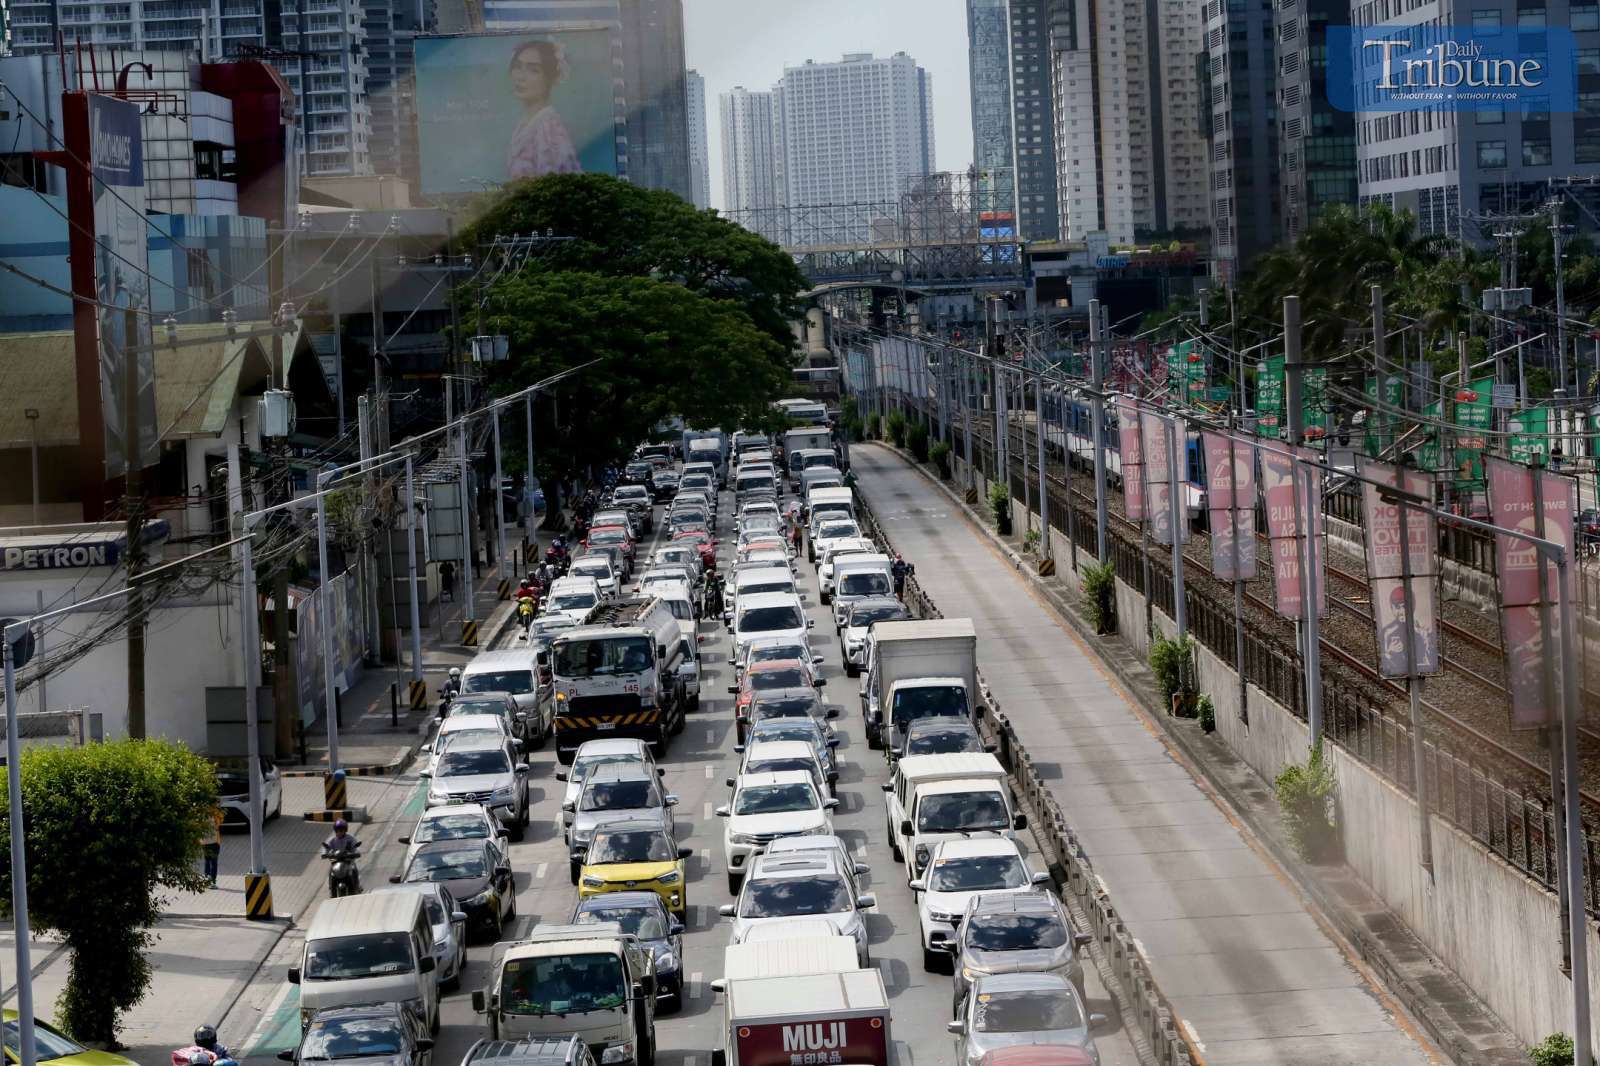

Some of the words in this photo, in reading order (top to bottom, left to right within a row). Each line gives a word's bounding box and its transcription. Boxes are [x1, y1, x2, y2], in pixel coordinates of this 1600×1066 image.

[4, 545, 106, 569] PETRON
[623, 685, 639, 694] 145
[782, 1021, 847, 1052] MUJI
[790, 1050, 842, 1066] 無印良品
